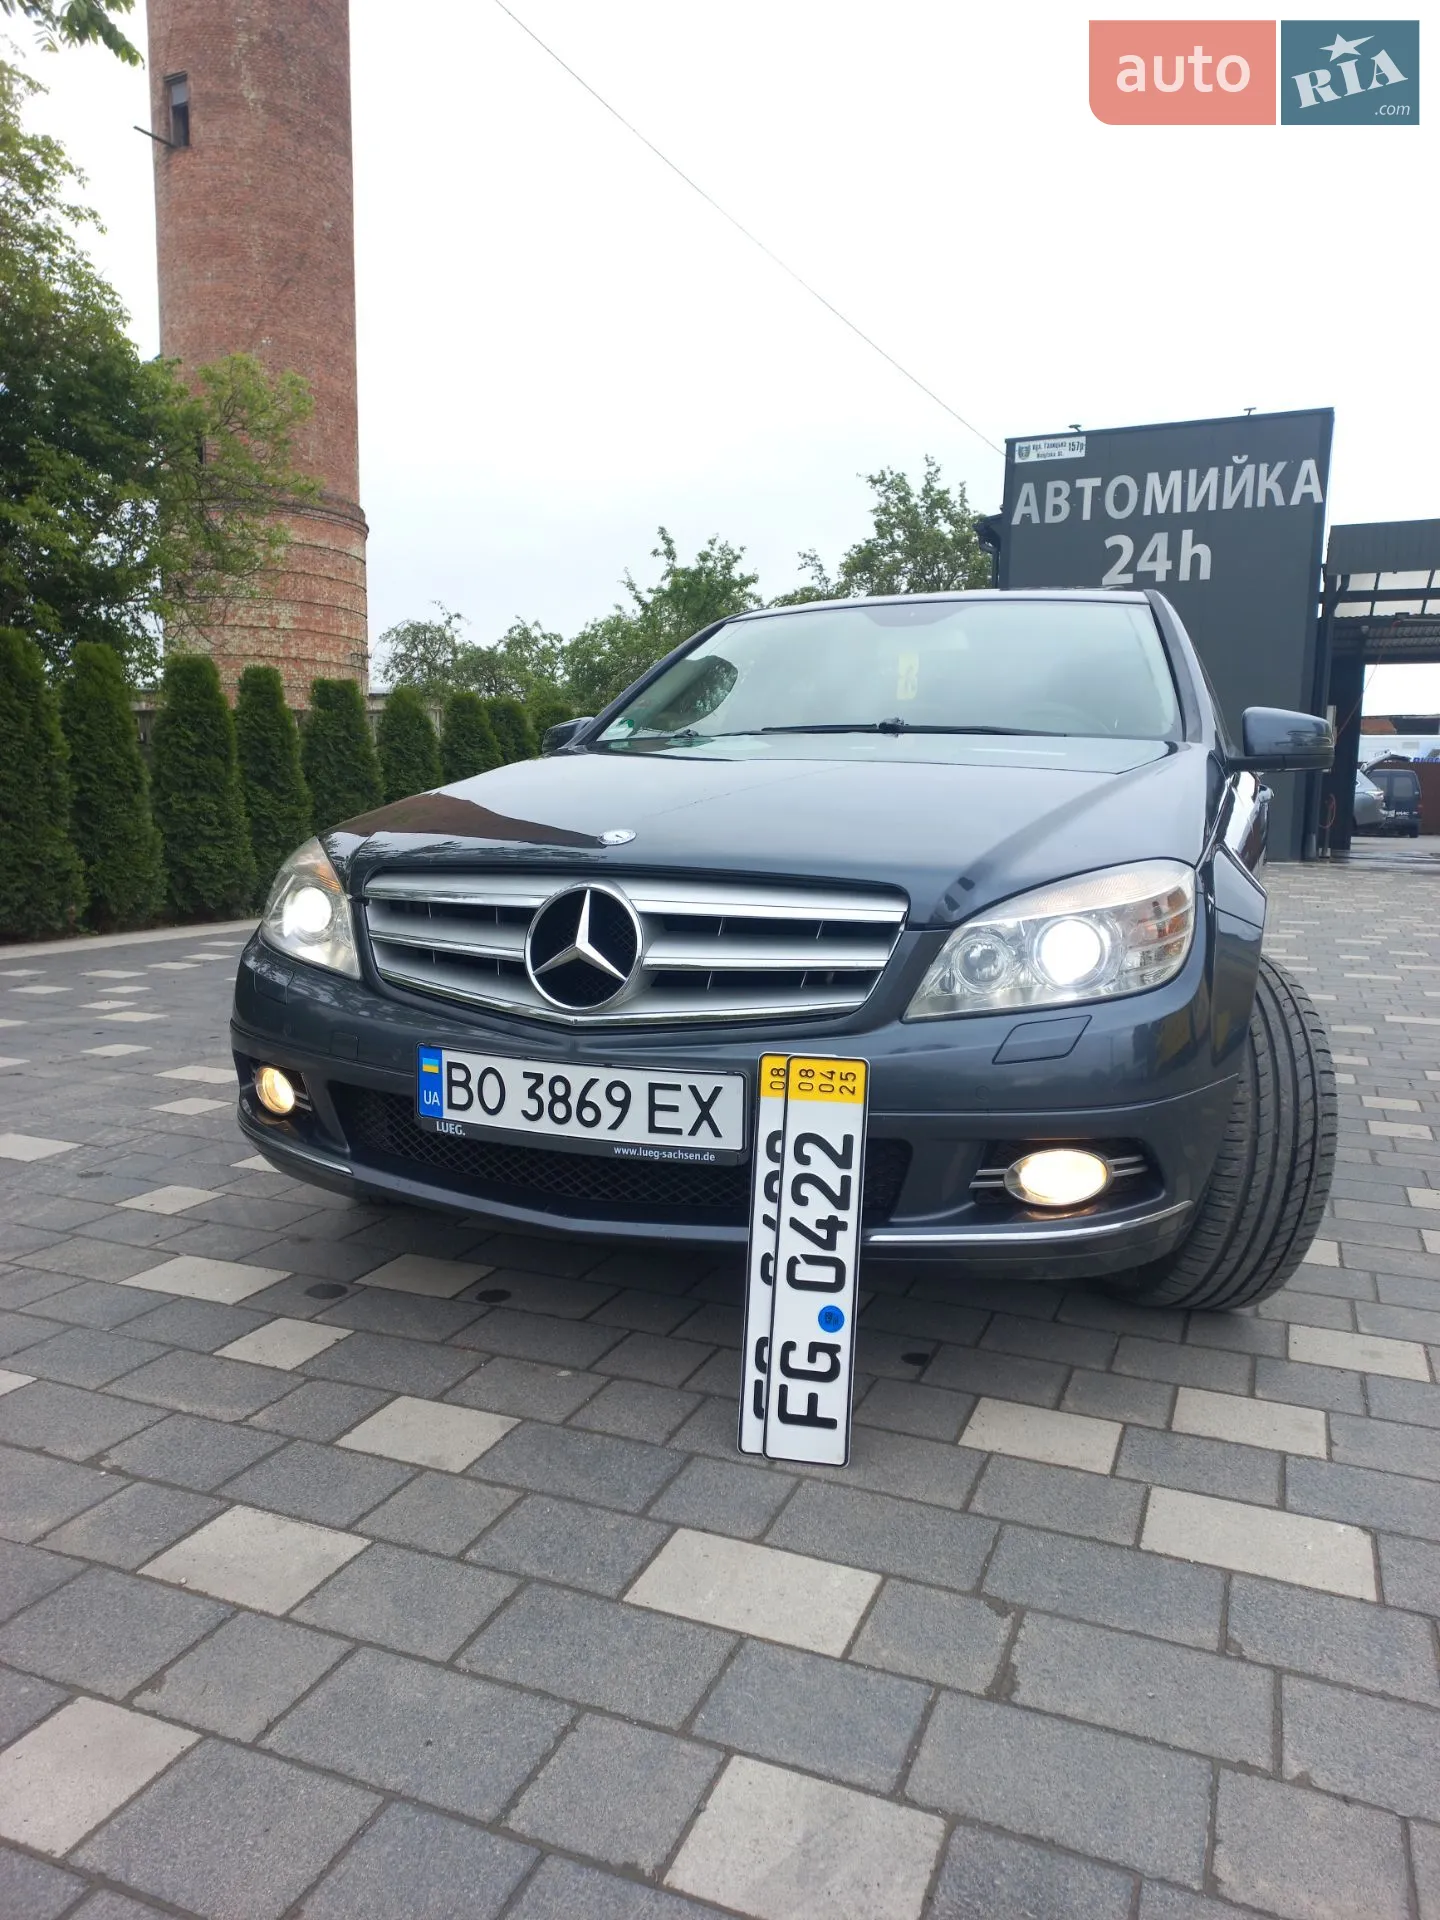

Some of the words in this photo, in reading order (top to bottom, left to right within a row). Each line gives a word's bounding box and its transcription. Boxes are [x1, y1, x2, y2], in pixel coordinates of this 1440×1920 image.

[1011, 454, 1324, 525] АВТОМИЙКА
[1101, 529, 1212, 586] 24h
[797, 1068, 815, 1091] 08
[818, 1069, 836, 1093] 04
[839, 1071, 857, 1096] 25
[423, 1089, 440, 1107] UA
[446, 1061, 506, 1116] BO
[521, 1071, 632, 1131] 3869
[647, 1081, 723, 1138] EX
[436, 1121, 466, 1136] LUEG.
[613, 1146, 716, 1162] www.lueg-sachsen.de
[786, 1131, 854, 1294] 0422
[777, 1339, 842, 1430] FG
